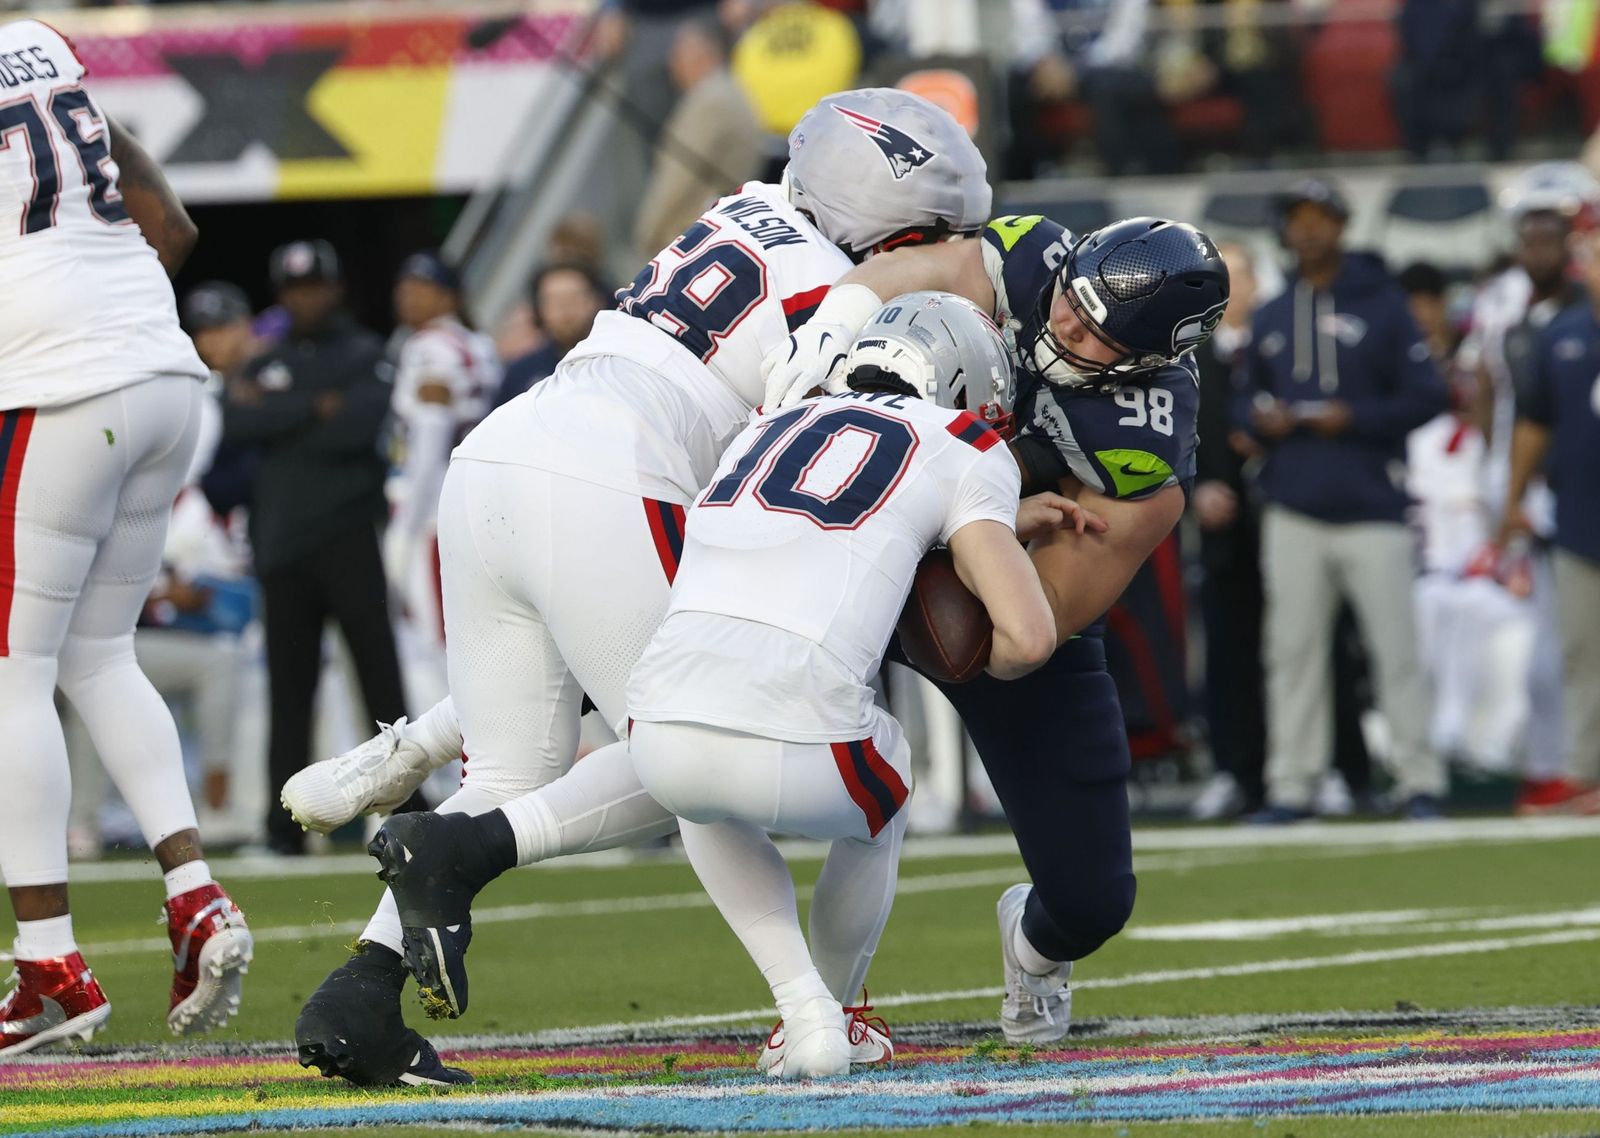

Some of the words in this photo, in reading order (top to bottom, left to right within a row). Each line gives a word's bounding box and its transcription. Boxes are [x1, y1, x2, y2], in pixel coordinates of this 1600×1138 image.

[0, 46, 59, 89] OSES
[0, 82, 134, 236] 76
[716, 195, 808, 251] WILSON
[875, 306, 903, 325] 10
[1114, 386, 1174, 437] 98
[698, 403, 920, 531] 10
